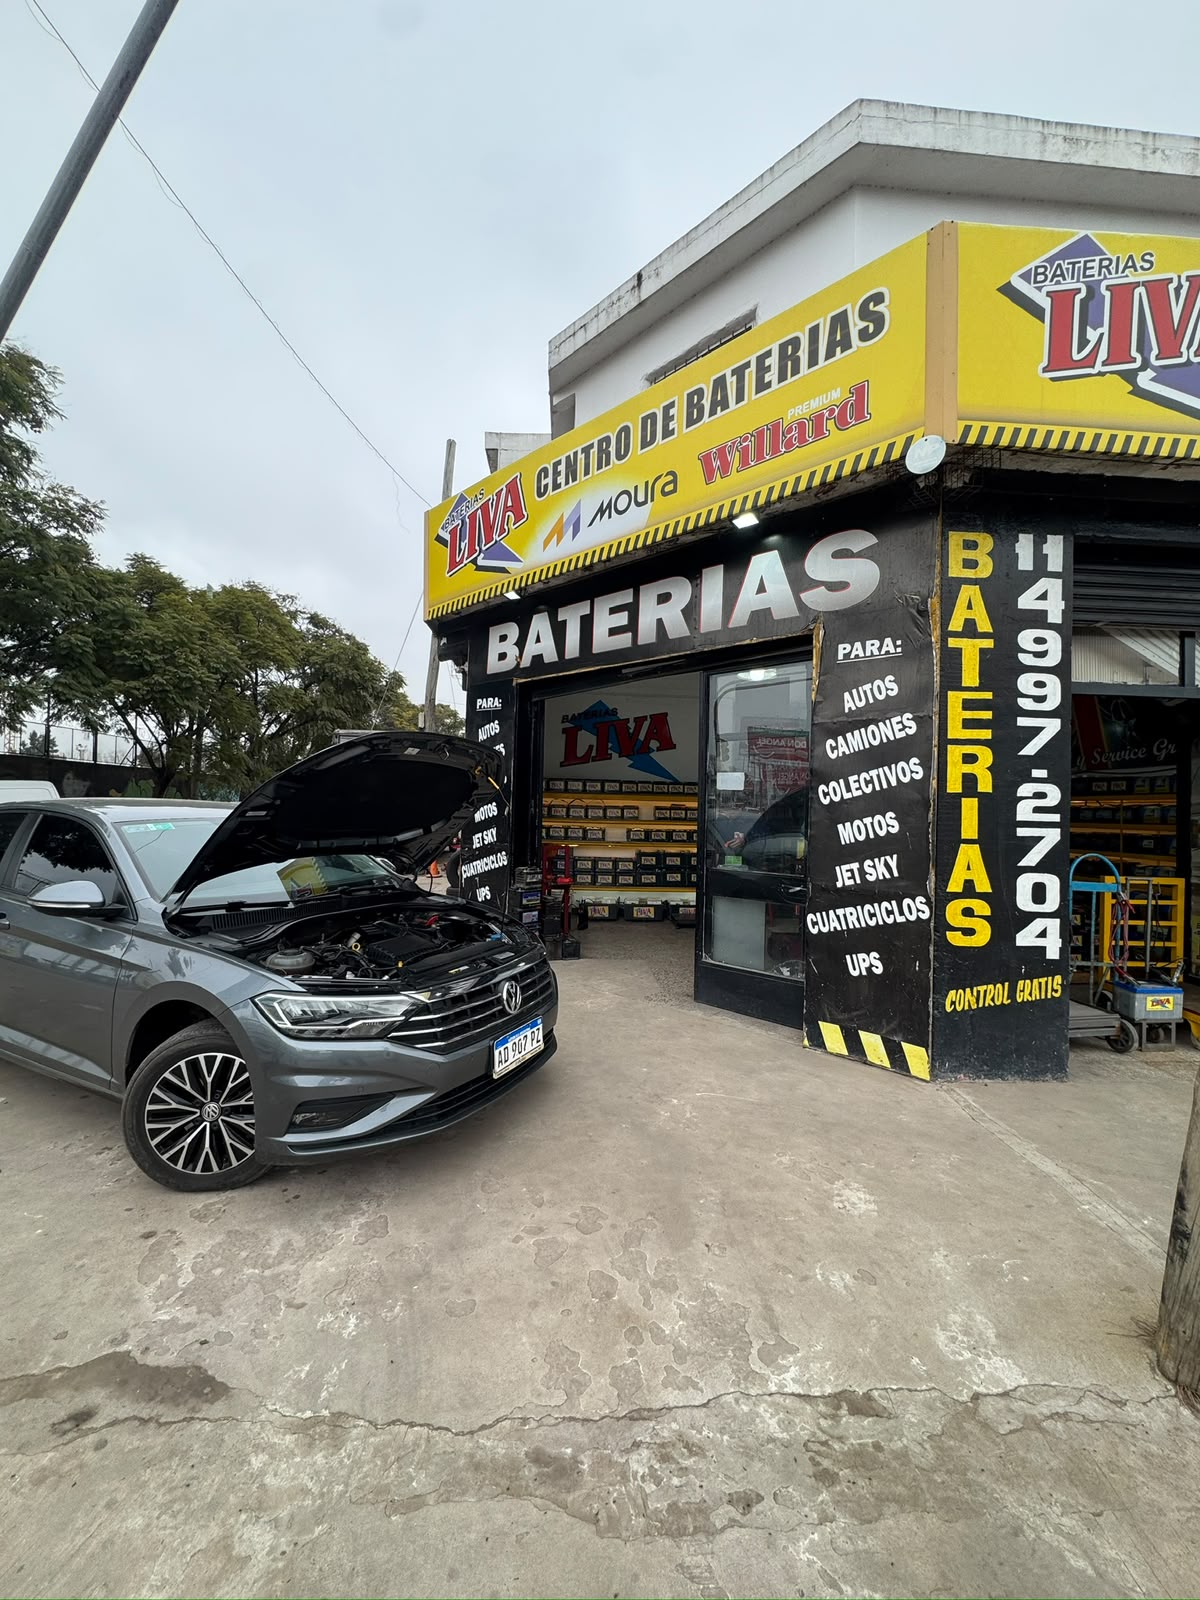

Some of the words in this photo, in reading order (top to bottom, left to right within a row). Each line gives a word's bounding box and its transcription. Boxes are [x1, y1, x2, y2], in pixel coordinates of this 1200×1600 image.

[1032, 251, 1155, 285] BATERIAS
[1041, 274, 1200, 375] LIV
[535, 423, 632, 500] CENTRO
[639, 398, 677, 453] DE
[684, 289, 889, 431] BATERIAS
[787, 386, 841, 419] PREMIUM
[698, 379, 871, 485] Willard
[441, 488, 485, 533] BATERIAS
[446, 473, 527, 576] LIVA
[486, 529, 881, 676] BATERIAS
[837, 636, 903, 662] PARA:
[476, 697, 502, 710] PARA:
[843, 674, 899, 714] AUTOS
[478, 719, 500, 742] AUTOS
[561, 707, 619, 724] BATERIAS
[560, 711, 677, 768] LIVA
[825, 712, 917, 760] CAMIONES
[945, 530, 995, 948] BATERIAS
[1091, 746, 1147, 765] Service
[817, 756, 924, 806] COLECTIVOS
[474, 801, 498, 823] MOTOS
[837, 811, 900, 846] MOTOS
[472, 833, 483, 849] JET
[482, 826, 497, 846] SKY
[461, 851, 508, 880] CUATRICICLOS
[834, 861, 862, 889] JET
[863, 853, 900, 882] SKY
[476, 885, 491, 902] UPS
[806, 895, 931, 935] CUATRICICLOS
[845, 951, 884, 977] UPS
[945, 982, 1011, 1013] CONTROL
[1016, 974, 1062, 1003] GRATIS
[498, 1046, 509, 1068] AD
[512, 1034, 528, 1059] 907
[530, 1027, 541, 1047] PZ
